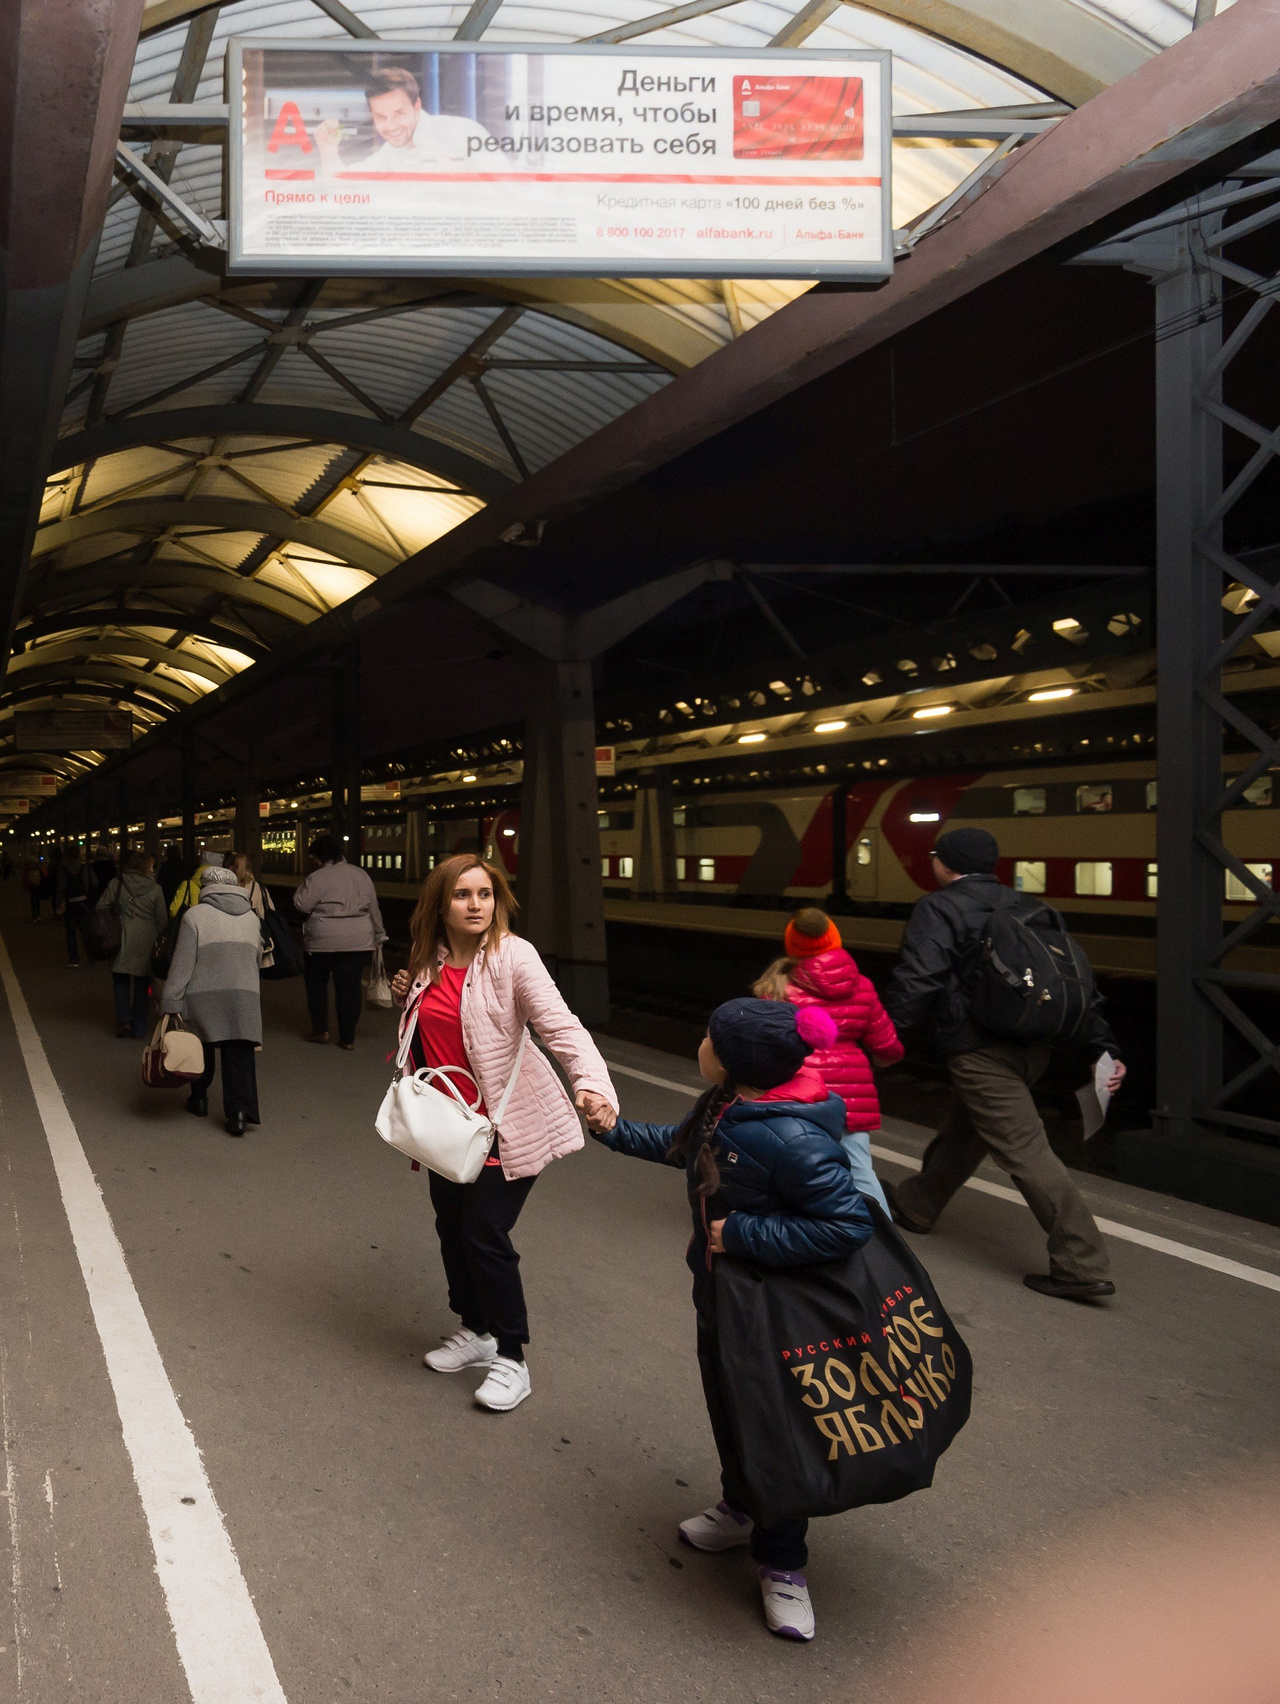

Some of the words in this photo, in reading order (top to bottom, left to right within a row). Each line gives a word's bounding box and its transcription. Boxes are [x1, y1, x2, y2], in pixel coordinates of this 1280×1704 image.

[618, 70, 716, 96] Деньги
[505, 105, 520, 121] и
[530, 104, 624, 126] время,
[633, 102, 717, 123] чтобы
[467, 134, 644, 157] реализовать
[653, 132, 717, 155] себя
[265, 190, 315, 205] Прямо
[320, 193, 328, 203] к
[334, 194, 370, 205] цели
[596, 194, 676, 210] Кредитная
[681, 198, 721, 210] карта
[726, 196, 760, 210] «100
[765, 197, 804, 211] дней
[809, 197, 836, 211] без
[841, 197, 864, 211] %»
[596, 227, 604, 238] 8
[607, 227, 629, 238] 800
[633, 227, 654, 238] 100
[657, 227, 686, 238] 2017
[697, 227, 772, 239] alfabank.ru
[795, 228, 864, 240] Альфа-Банк
[781, 1332, 872, 1361] РУССКИЙ
